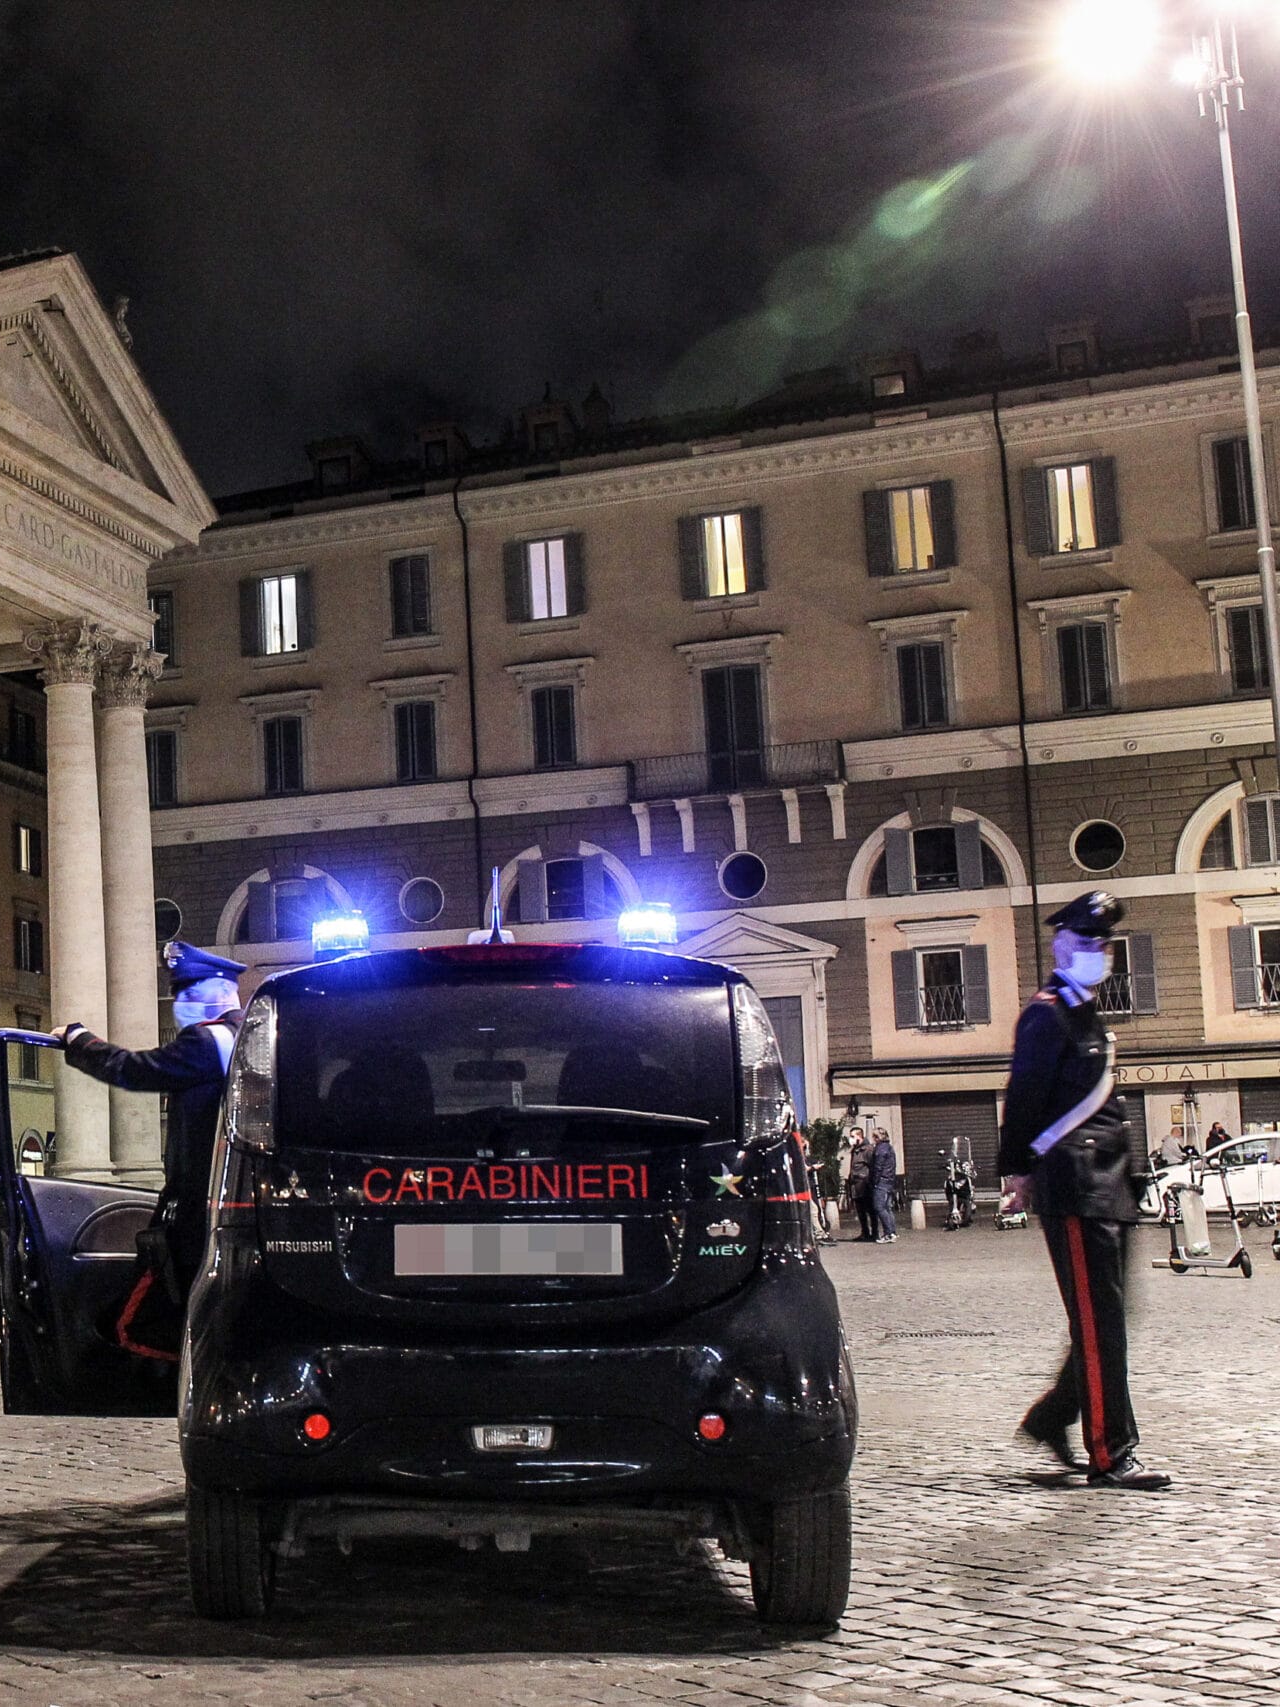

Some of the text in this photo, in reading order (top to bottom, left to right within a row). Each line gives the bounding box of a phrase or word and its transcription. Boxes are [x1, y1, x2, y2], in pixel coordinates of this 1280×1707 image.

[1117, 1063, 1226, 1082] ROSATI
[363, 1164, 649, 1203] CARABINIERI
[266, 1240, 333, 1253] MITSUBISHI
